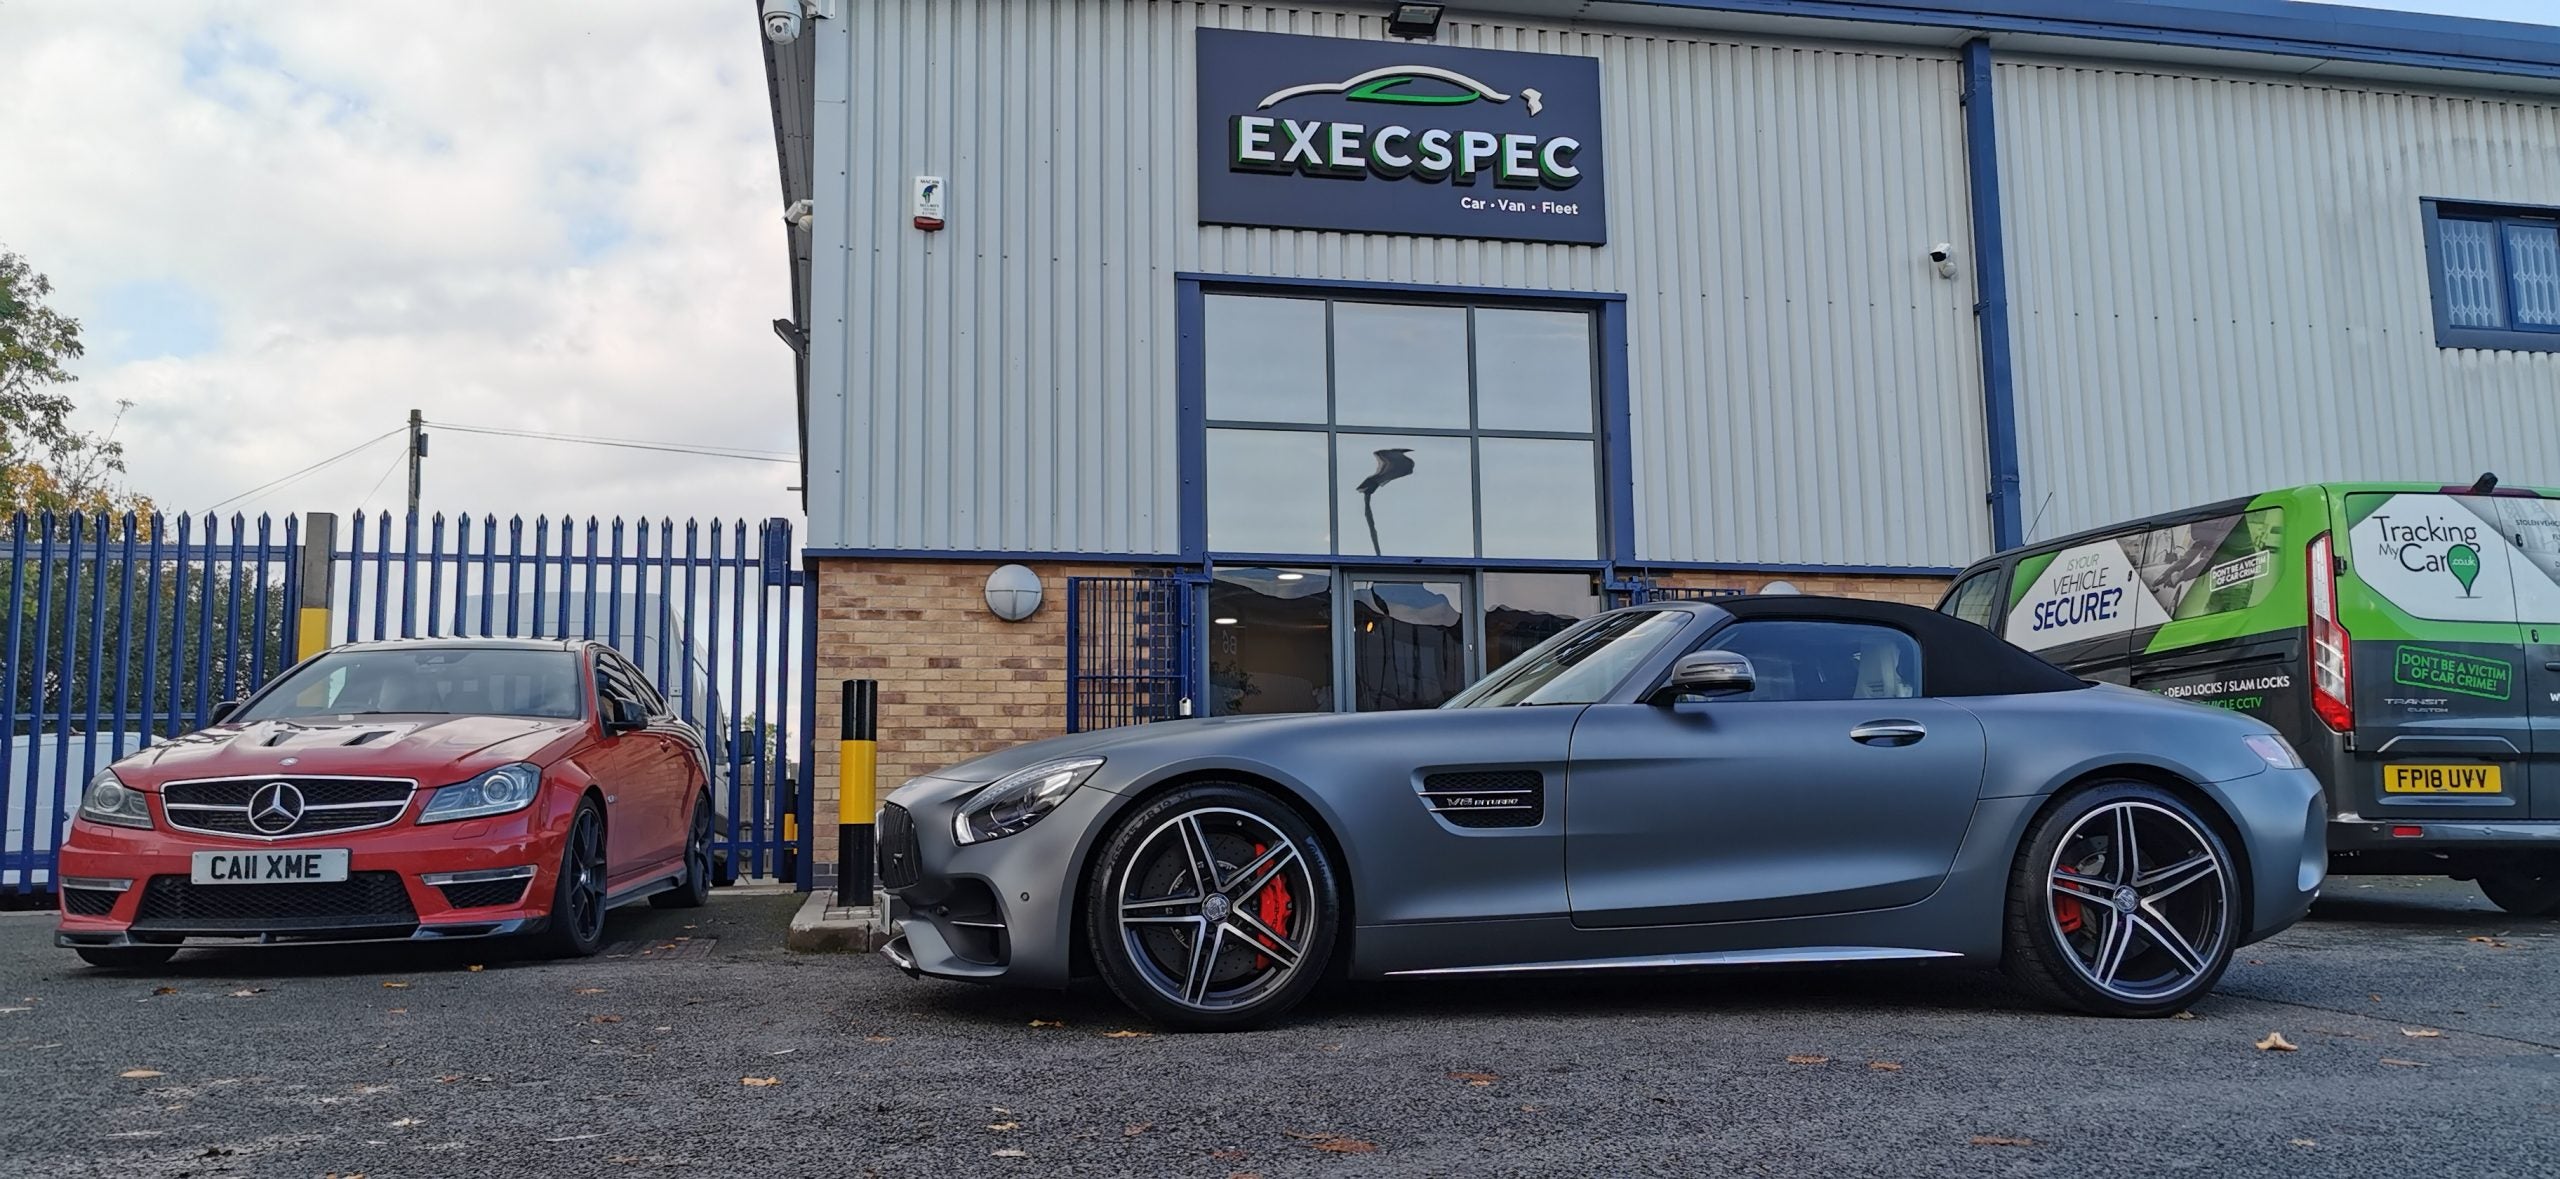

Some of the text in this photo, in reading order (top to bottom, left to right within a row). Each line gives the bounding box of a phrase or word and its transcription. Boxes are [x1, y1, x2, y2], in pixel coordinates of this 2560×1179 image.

[1236, 115, 1582, 182] EXECSPEC
[1461, 197, 1579, 215] Car Van Fleet
[2372, 515, 2481, 553] Tracking
[2075, 554, 2099, 569] YOUR
[2379, 544, 2399, 560] My
[2400, 543, 2447, 572] Car
[2054, 567, 2109, 596] VEHICLE
[2033, 587, 2122, 631] SECURE?
[2402, 653, 2506, 680] DON'T BE A VICTIM
[2411, 667, 2497, 691] OF CAR CRIME!
[2168, 686, 2192, 697] DEAD
[2193, 682, 2222, 695] LOCKS
[2229, 679, 2254, 692] SLAM
[2257, 676, 2290, 689] LOCKS
[2236, 696, 2262, 709] CCTV
[2397, 768, 2487, 789] FP18 UVV
[266, 854, 322, 879] XME
